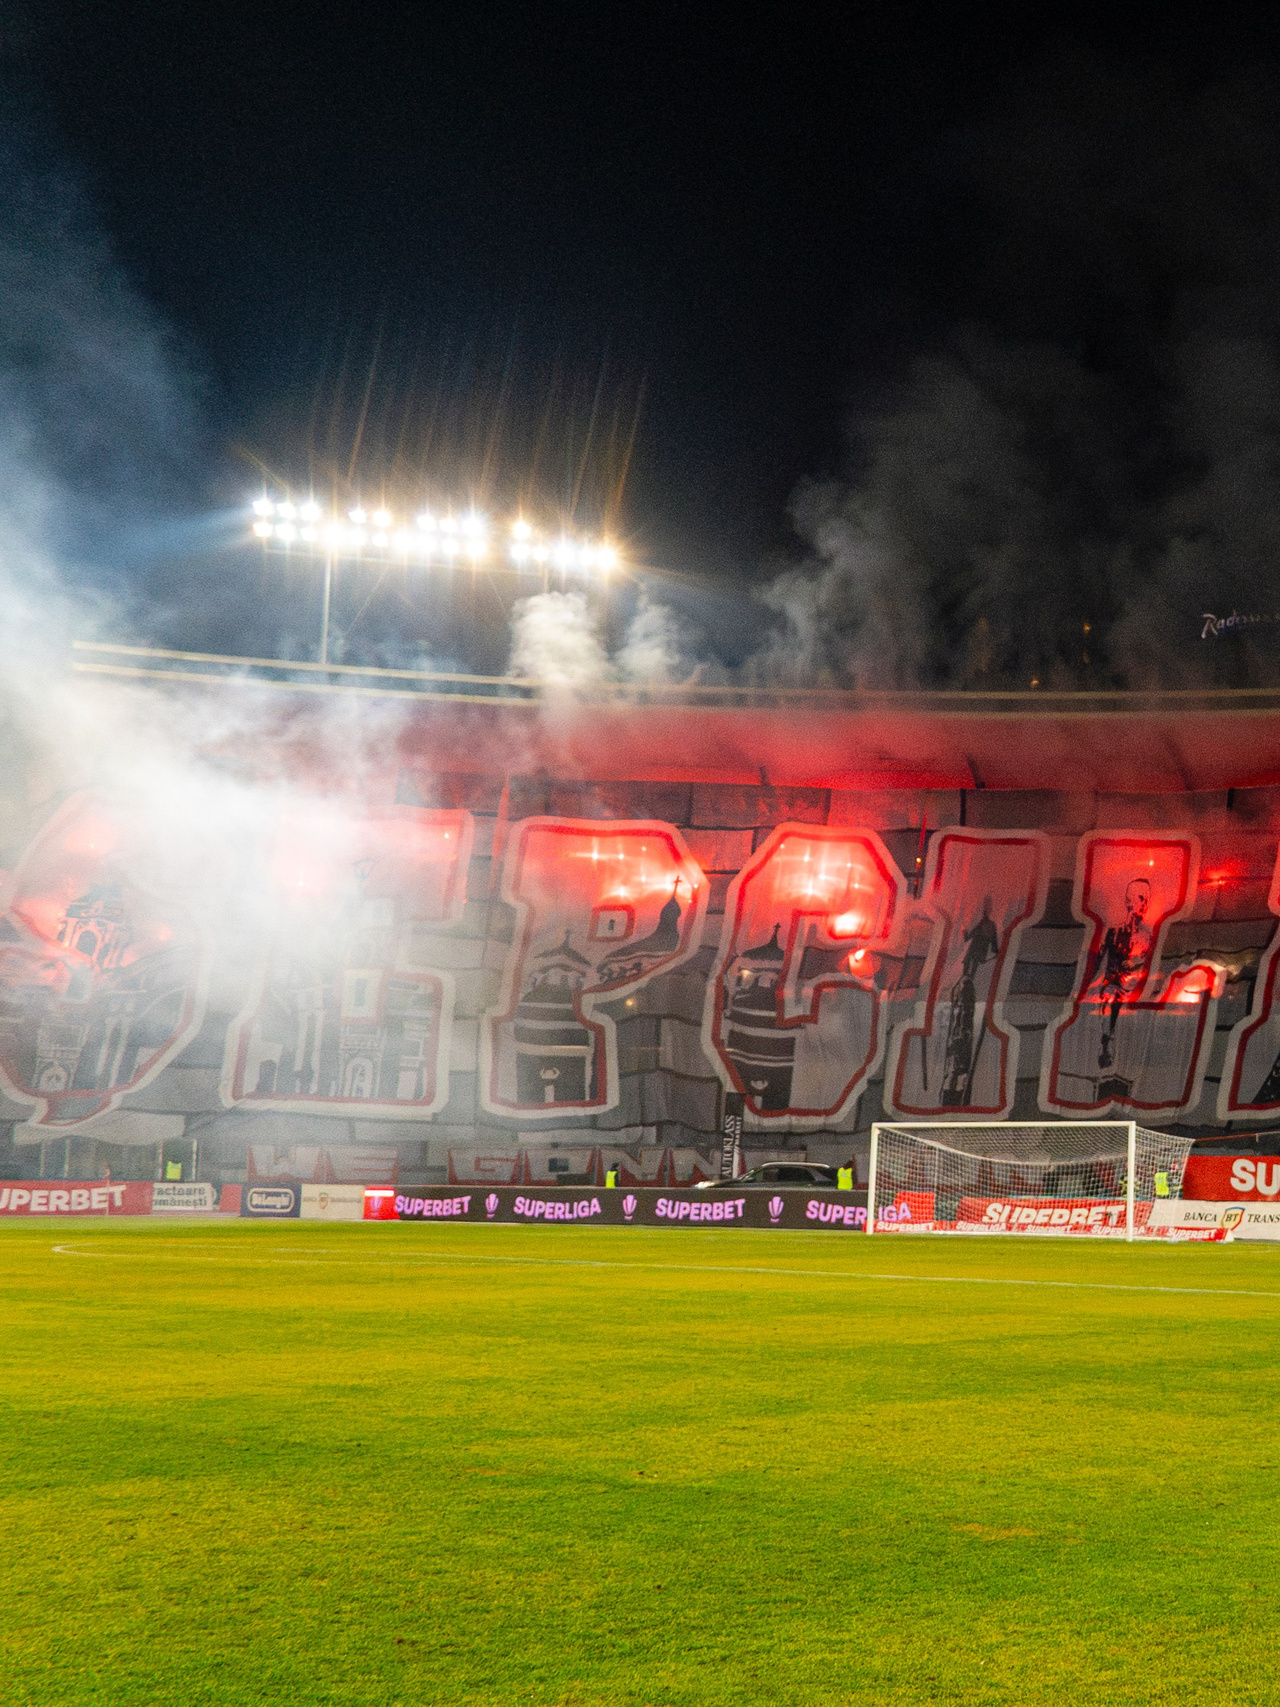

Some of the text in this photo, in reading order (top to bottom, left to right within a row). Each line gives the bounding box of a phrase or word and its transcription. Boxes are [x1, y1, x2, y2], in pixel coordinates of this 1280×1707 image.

[154, 1185, 206, 1196] actoare
[395, 1195, 471, 1217] SUPERBET
[514, 1196, 601, 1220] SUPERLIGA
[655, 1198, 746, 1221] SUPERBET
[806, 1200, 911, 1225] SUPERIGA
[1183, 1211, 1218, 1222] BANCA
[1226, 1213, 1240, 1222] BT
[876, 1220, 934, 1232] SUPERBET
[955, 1221, 1007, 1232] SUPERLIGA
[1091, 1223, 1146, 1236] SUPERGA
[1167, 1227, 1217, 1240] SUPERBET
